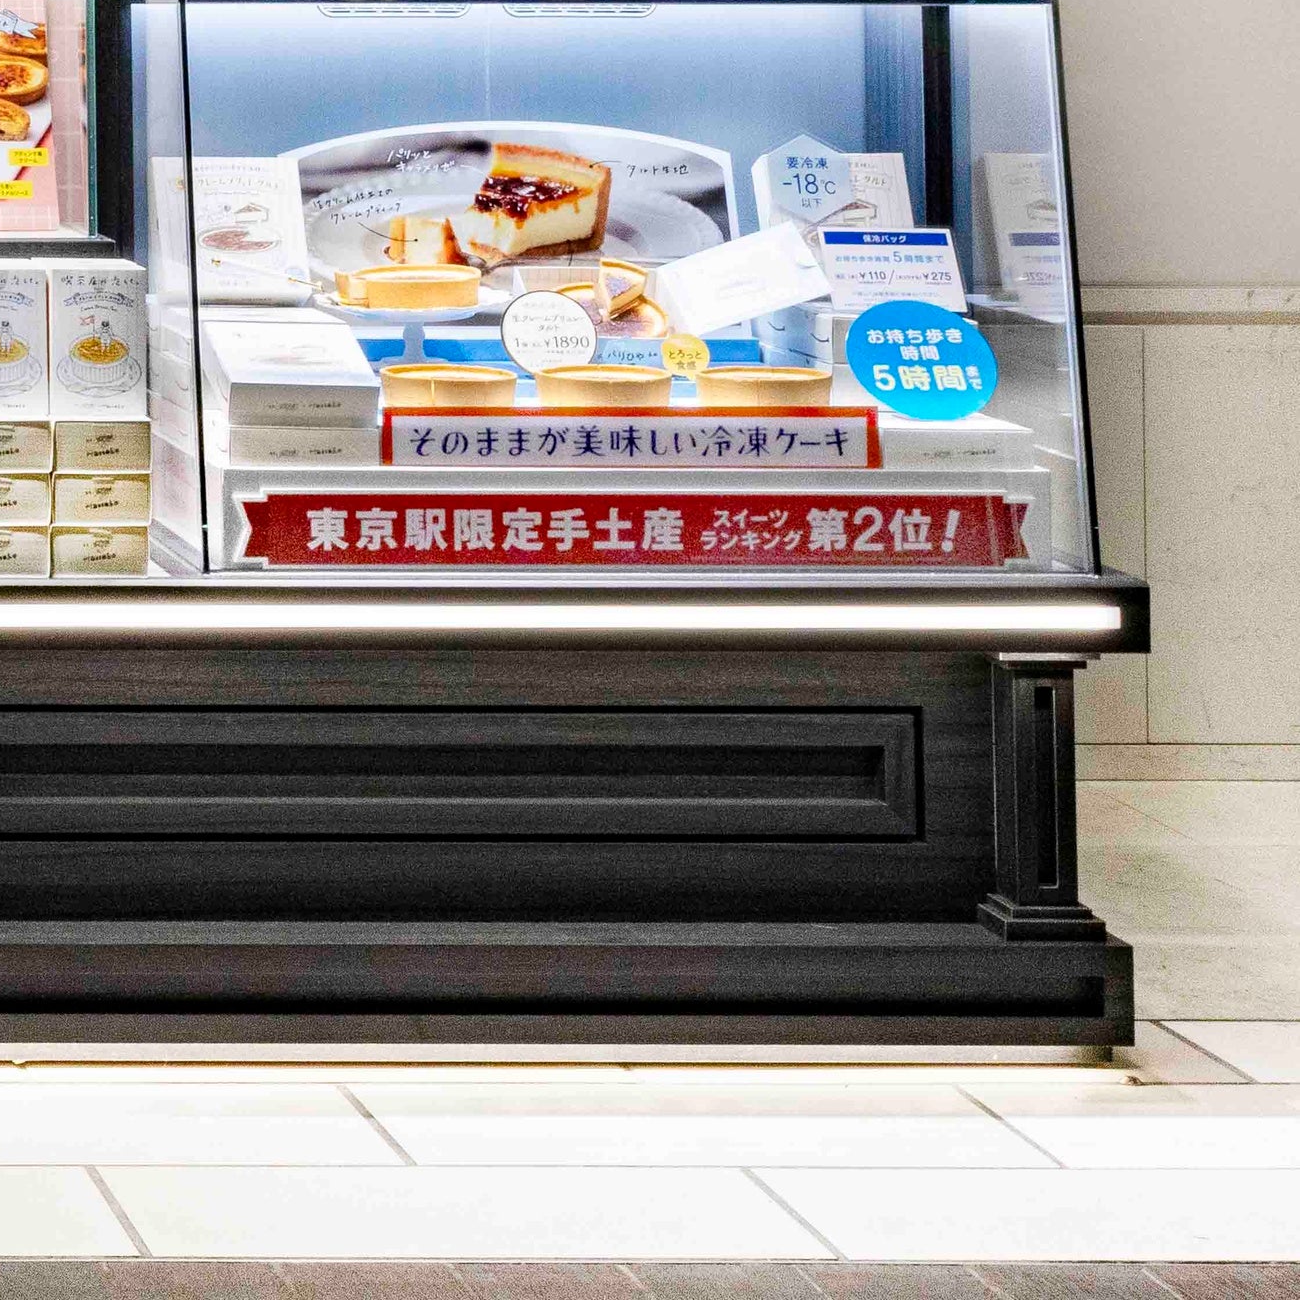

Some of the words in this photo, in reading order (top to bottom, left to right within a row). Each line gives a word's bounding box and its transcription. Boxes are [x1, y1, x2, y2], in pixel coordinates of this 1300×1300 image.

[786, 156, 829, 170] 要冷凍
[801, 197, 823, 208] 以下
[862, 233, 907, 245] 保冷バッグ
[858, 270, 887, 281] ¥110
[922, 271, 953, 281] ¥275
[543, 335, 590, 349] ¥1890
[866, 327, 963, 345] お持ち歩き
[668, 349, 705, 361] とろっと
[899, 344, 940, 361] 時間
[408, 424, 851, 459] そのままが美味しい冷凍ケーキ
[712, 509, 789, 529] スイーツ
[305, 507, 685, 554] 東京駅限定手土産
[699, 528, 804, 552] ランキング
